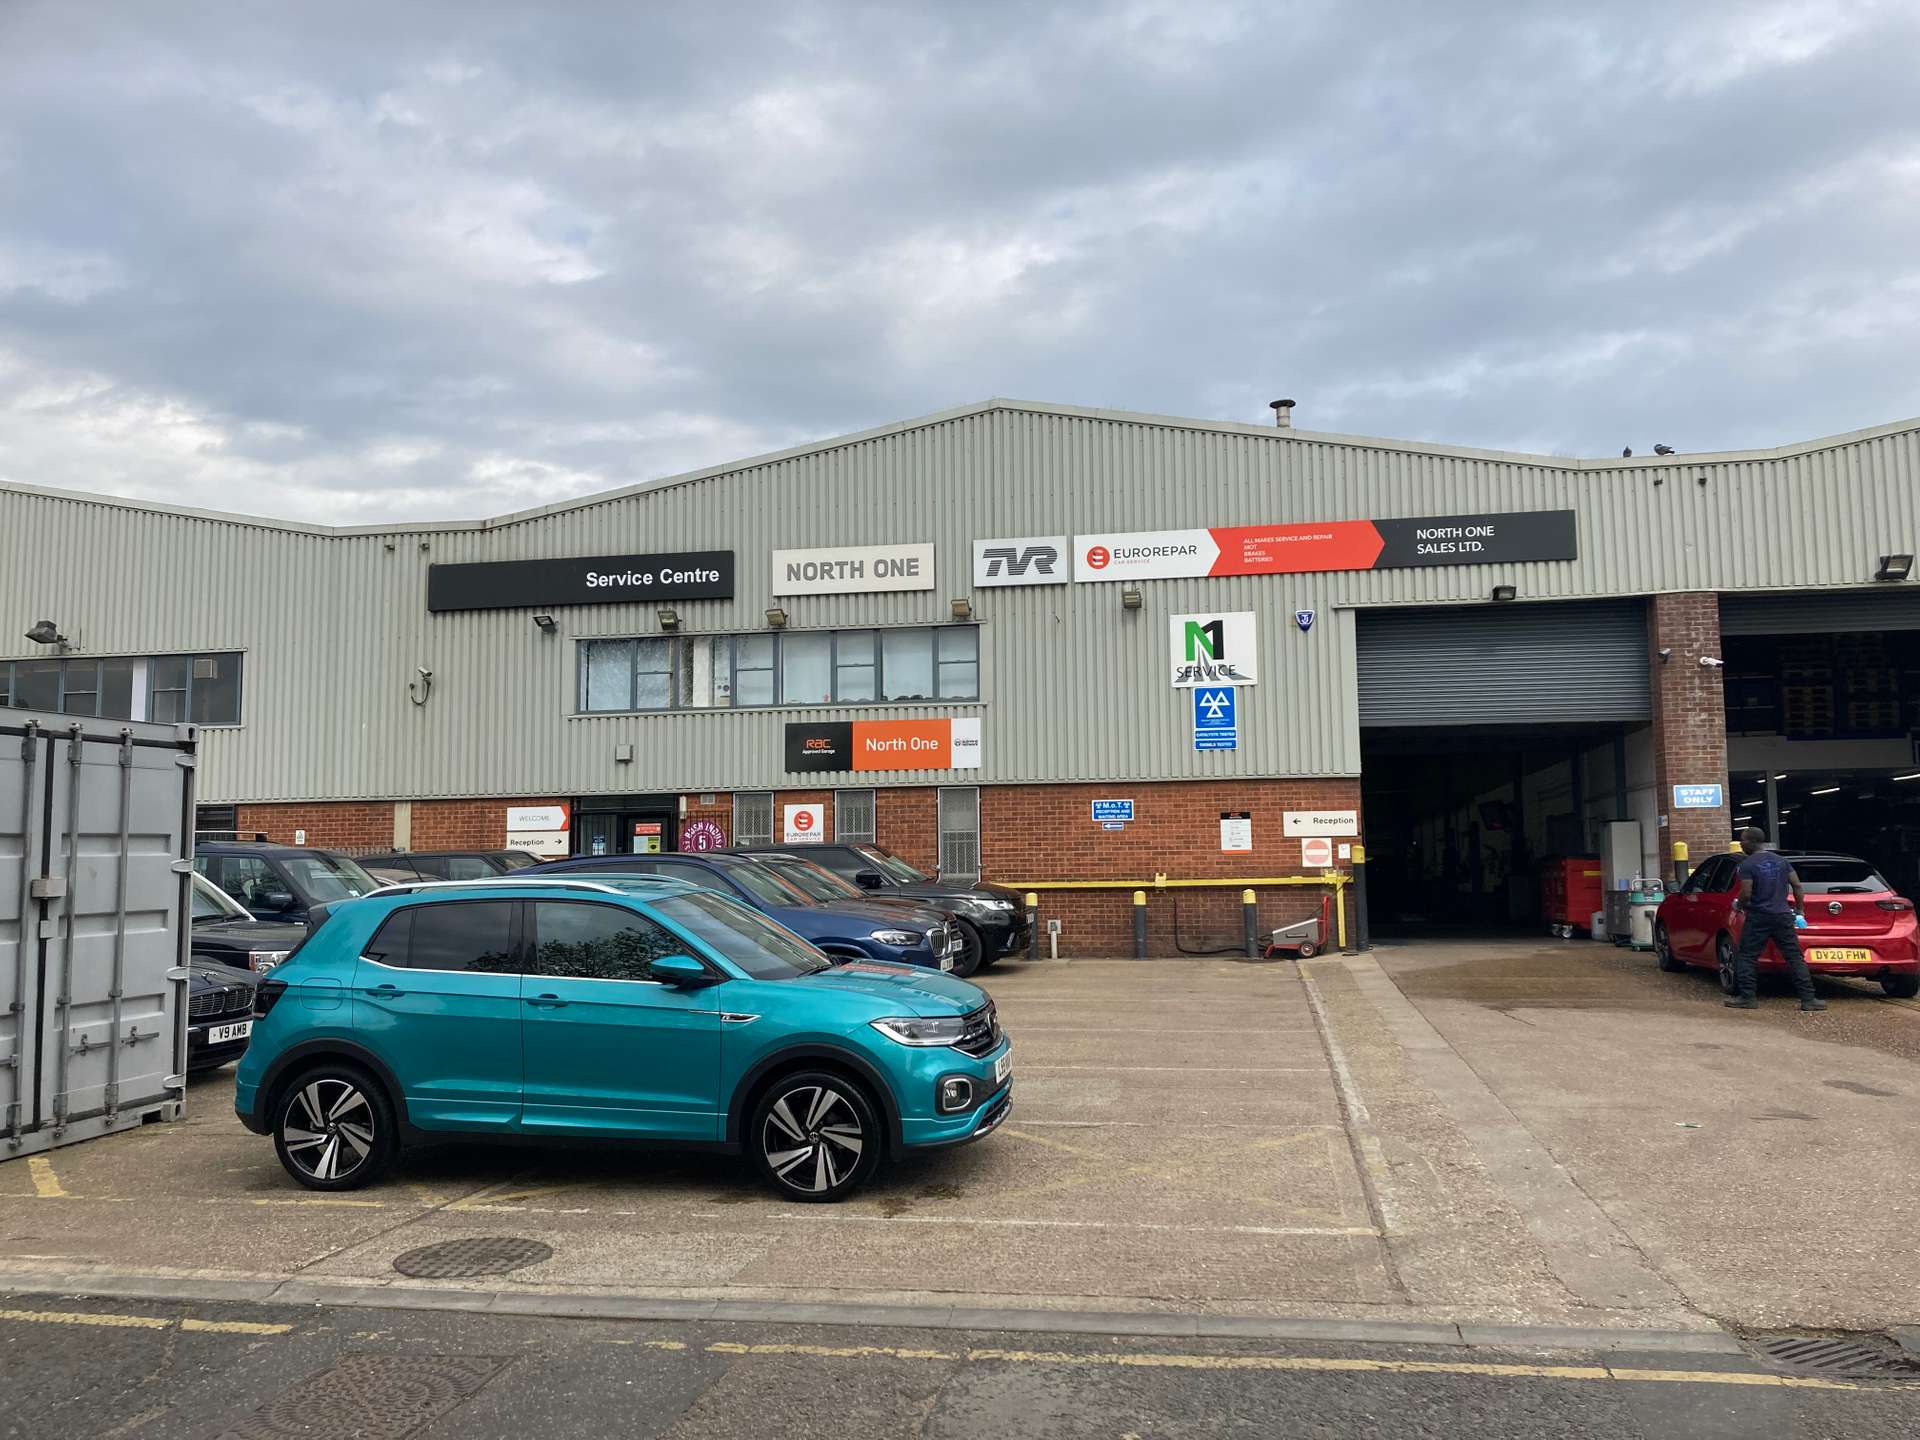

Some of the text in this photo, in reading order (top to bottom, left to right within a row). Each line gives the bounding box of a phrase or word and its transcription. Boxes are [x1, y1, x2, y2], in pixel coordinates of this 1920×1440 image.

[1416, 525, 1496, 540] NORTH ONE
[1113, 545, 1198, 559] EUROREPAR
[1417, 541, 1485, 555] SALES LTD.
[983, 546, 1058, 577] TVR
[585, 568, 720, 587] Service Centre
[786, 558, 920, 582] NORTH ONE
[1184, 619, 1225, 662] N1
[1176, 664, 1236, 679] SERVICE
[866, 736, 939, 752] North One
[1680, 788, 1715, 804] STAFF ONLY
[1313, 817, 1354, 825] Reception
[510, 839, 545, 847] Reception
[698, 835, 707, 850] 5
[1815, 950, 1867, 960] DV20 FHW
[218, 1023, 248, 1039] V9 AMB
